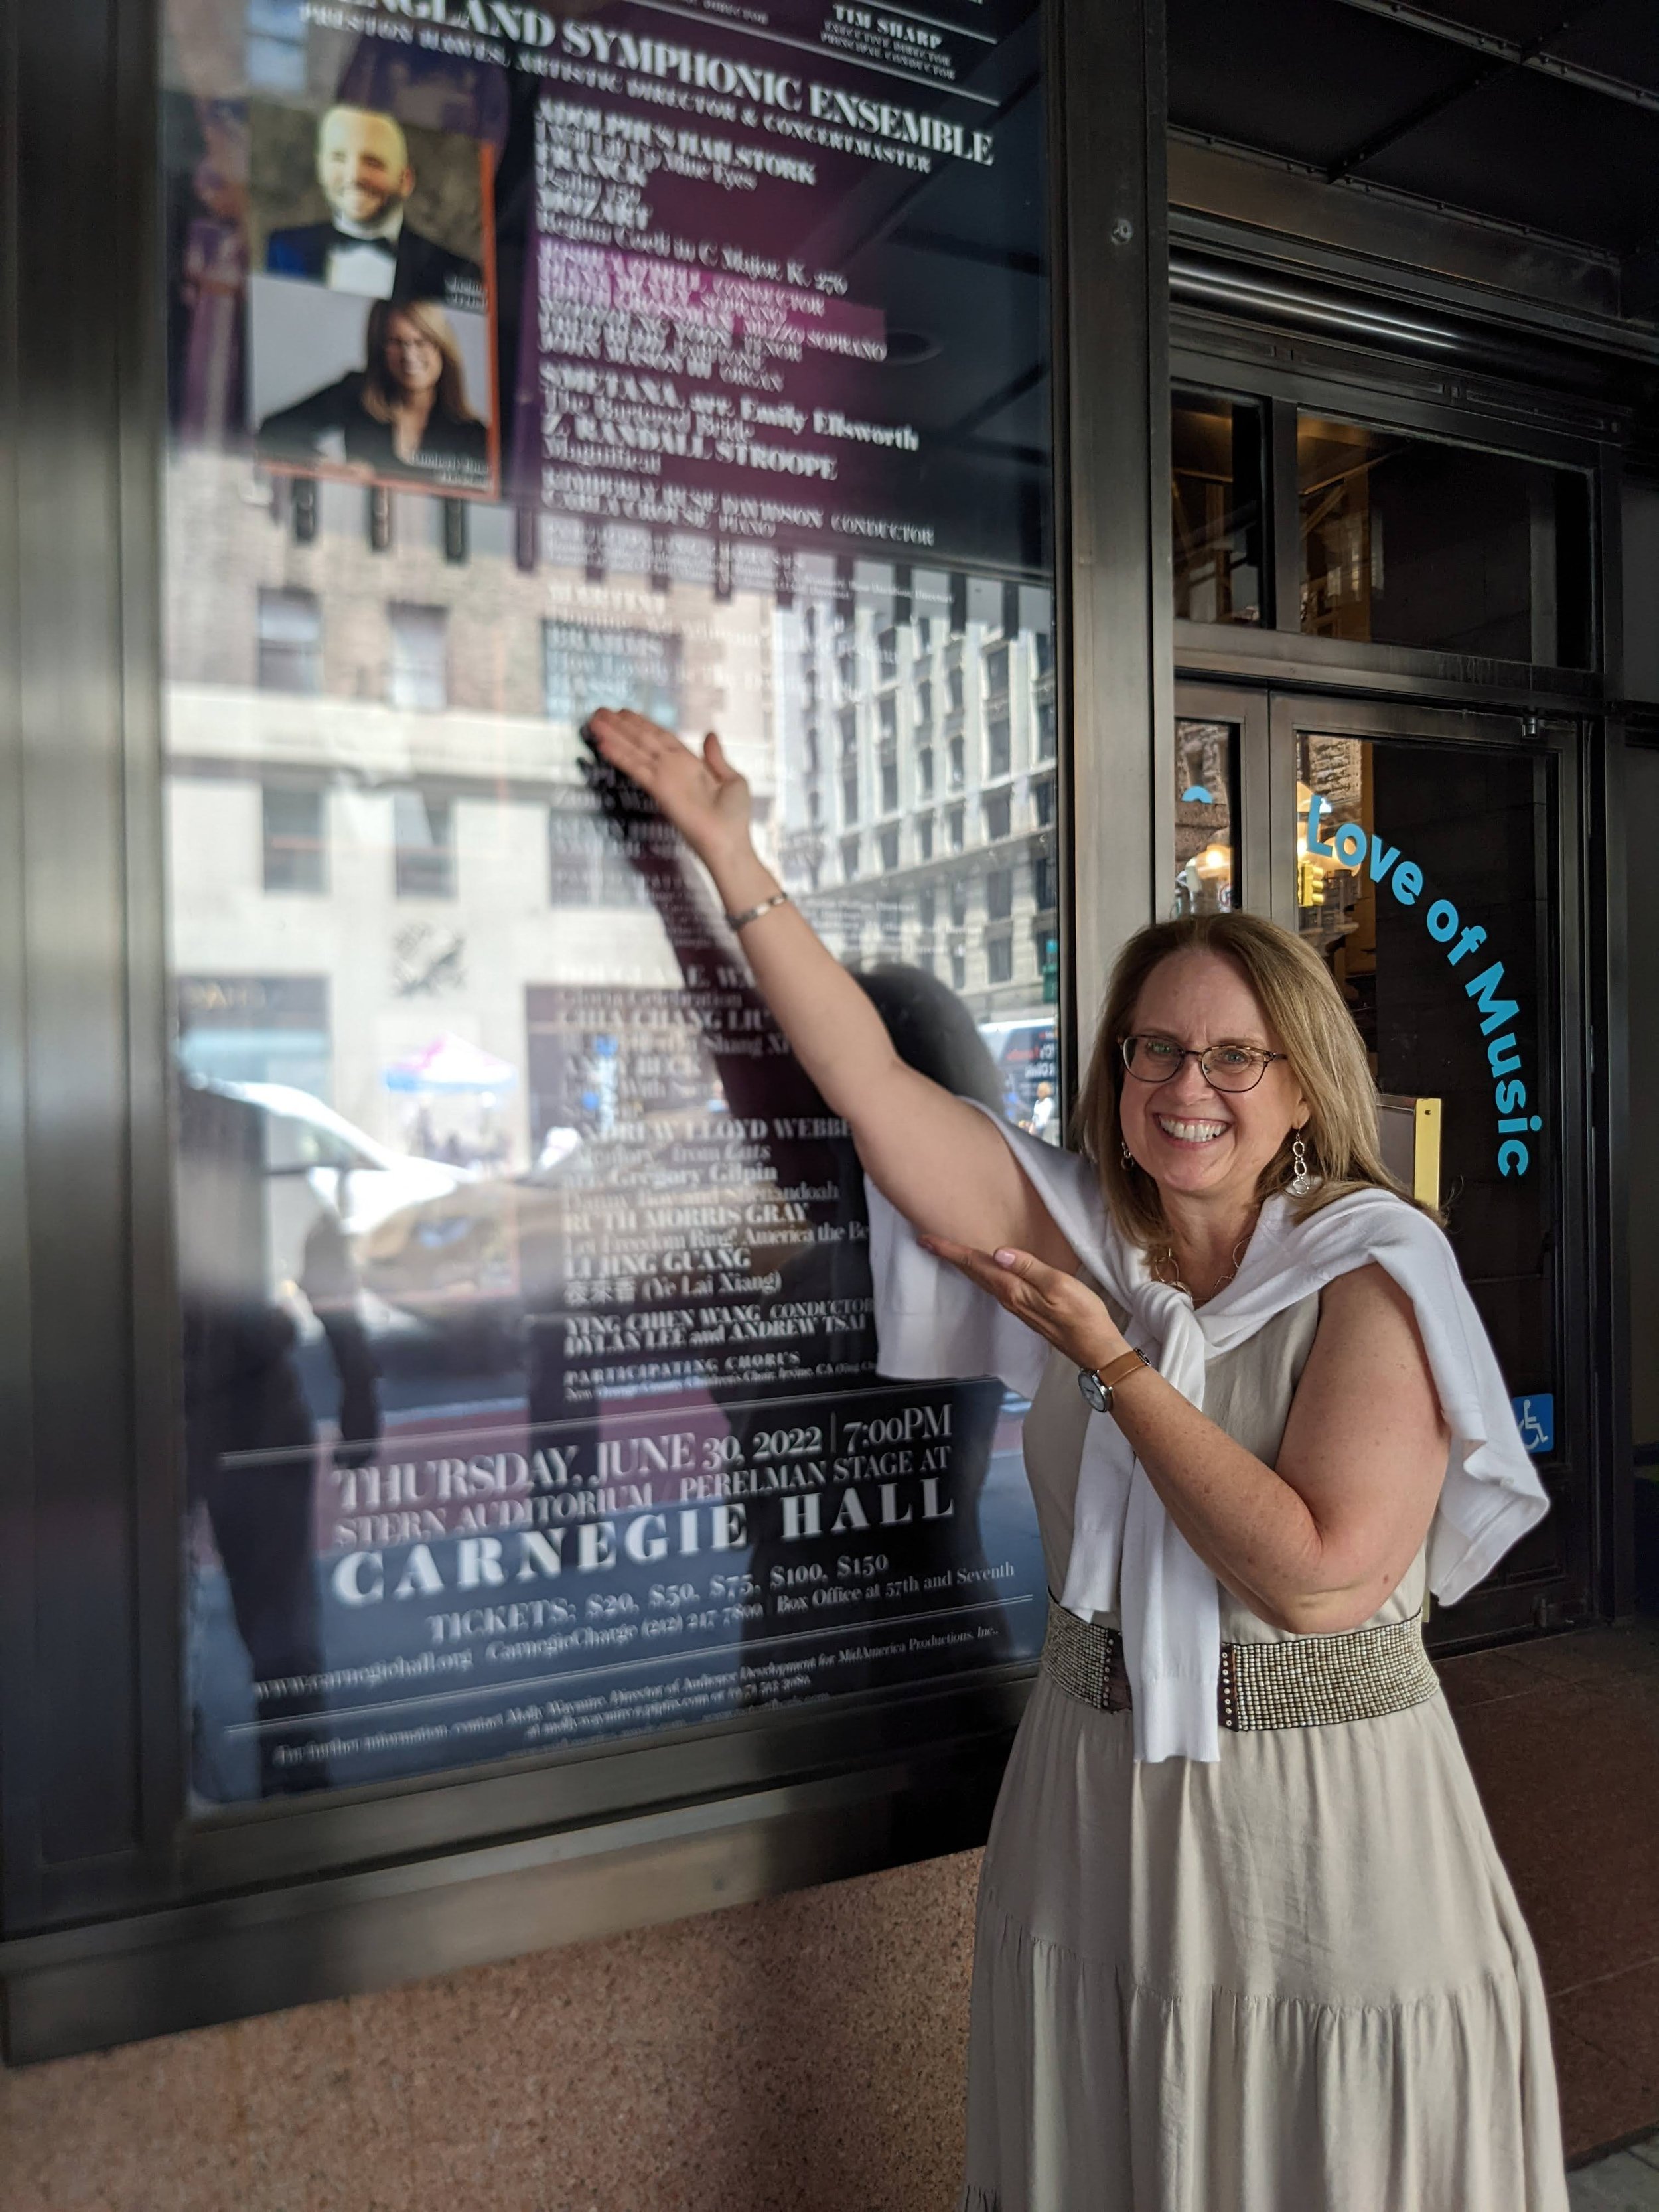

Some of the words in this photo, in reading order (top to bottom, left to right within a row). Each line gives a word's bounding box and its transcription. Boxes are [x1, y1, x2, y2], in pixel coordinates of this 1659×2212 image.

[833, 3, 871, 29] TIM
[876, 18, 942, 50] SHARP
[563, 19, 801, 111] SYMPHONIC
[809, 82, 993, 166] ENSEMBLE
[627, 74, 737, 123] DIRECTOR
[741, 105, 758, 128] &
[763, 111, 932, 174] CONCERTMASTER
[698, 240, 718, 267] C
[740, 394, 808, 435] Emily
[812, 408, 920, 451] Ellsworth
[715, 438, 839, 481] STROOPE
[831, 513, 934, 547] CONDUCTOR
[1306, 794, 1423, 905] Love
[1426, 899, 1487, 966] of
[1465, 960, 1542, 1177] Music
[685, 1118, 768, 1141] LLOYD
[773, 1116, 853, 1140] WEBBE
[707, 1158, 778, 1187] Gilpin
[563, 1208, 638, 1233] RUTH
[644, 1203, 741, 1229] MORRIS
[745, 1202, 808, 1224] GRAY
[745, 1223, 816, 1246] America
[818, 1222, 848, 1241] the
[663, 1247, 751, 1273] GUANG
[641, 1276, 677, 1301] (Ye
[680, 1274, 715, 1299] Lai
[718, 1269, 782, 1297] Xiang)
[689, 1322, 725, 1347] and
[729, 1317, 816, 1343] ANDREW
[824, 1313, 866, 1335] TSAI
[563, 1357, 719, 1389] PARTICIPATING
[724, 1349, 800, 1372] CHORUS
[816, 1361, 835, 1376] CA
[334, 1443, 585, 1512] THURSDAY,
[587, 1430, 696, 1490] JUNE
[701, 1436, 745, 1473] 30,
[752, 1425, 823, 1461] 2022
[842, 1402, 954, 1455] 7:00PM
[334, 1505, 449, 1549] STERN
[459, 1482, 654, 1531] AUDITORIUM
[680, 1459, 828, 1503] PERELMAN
[832, 1450, 914, 1484] STAGE
[920, 1445, 952, 1473] AT
[334, 1501, 748, 1607] CARNEGIE
[780, 1476, 954, 1543] HALL
[425, 1598, 576, 1646] TICKETS:
[648, 1582, 701, 1611] $50,
[709, 1573, 762, 1600] $75,
[769, 1560, 829, 1590] $100,
[837, 1552, 890, 1579] $150
[485, 1623, 639, 1661] CarnegieCharge
[776, 1593, 808, 1615] Box
[812, 1586, 863, 1608] Office
[864, 1584, 881, 1600] at
[885, 1575, 920, 1599] 57th
[923, 1572, 953, 1589] and
[956, 1560, 1015, 1586] Seventh
[739, 1655, 816, 1682] Development
[818, 1651, 837, 1668] for
[838, 1641, 906, 1664] MidAmerica
